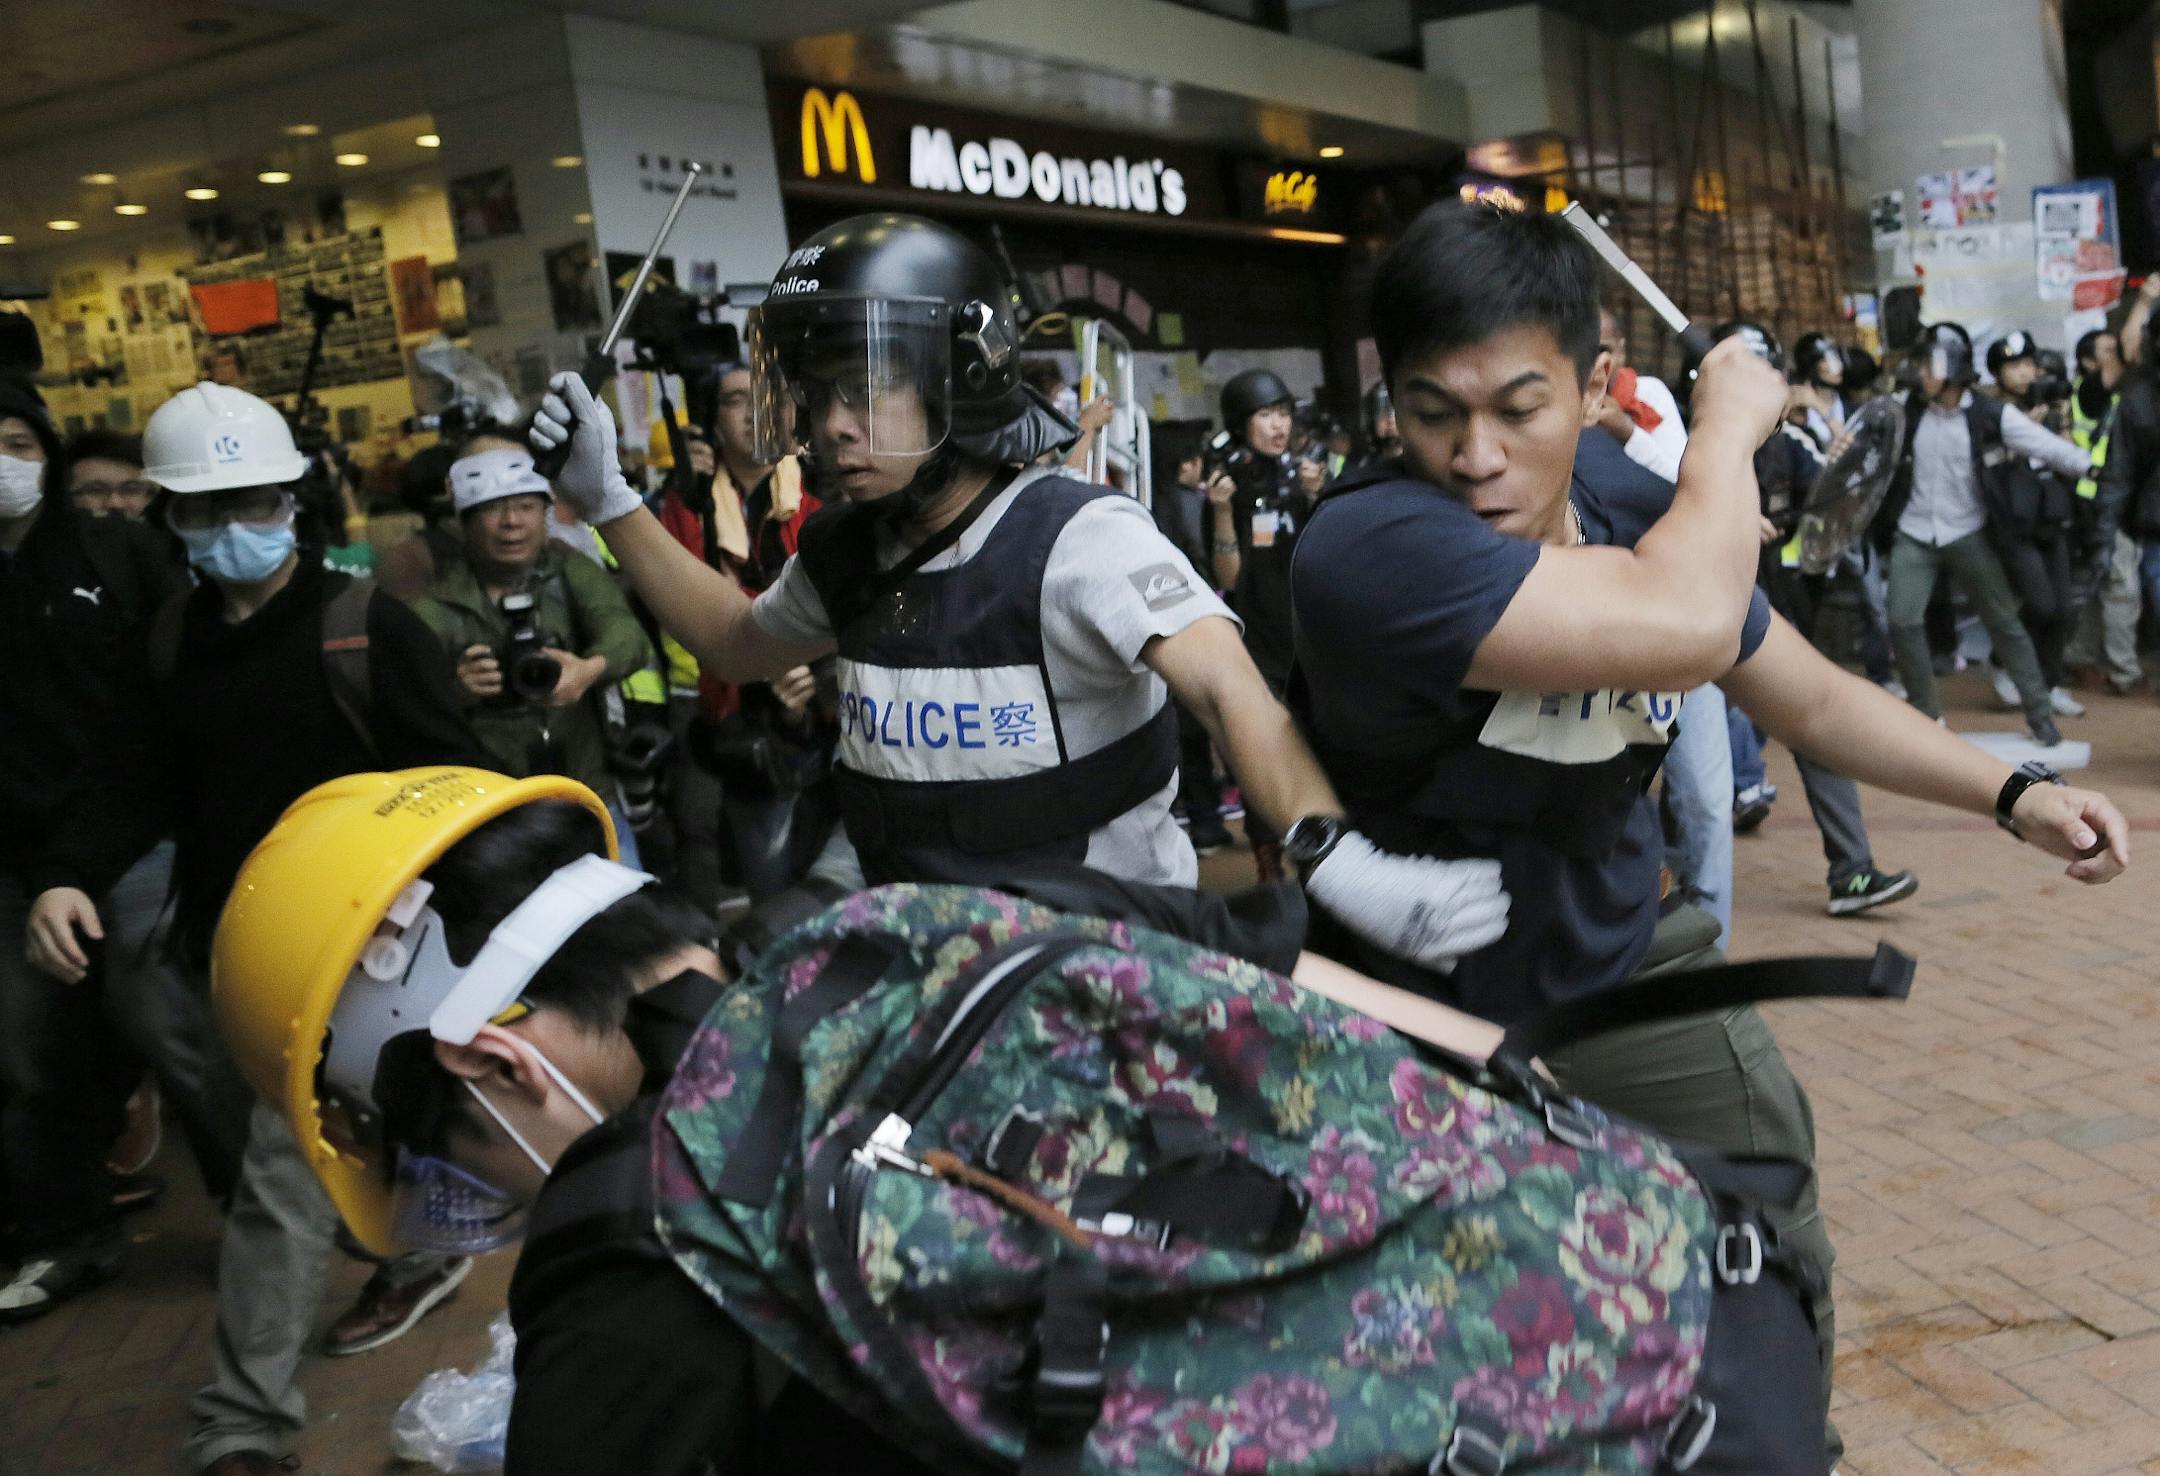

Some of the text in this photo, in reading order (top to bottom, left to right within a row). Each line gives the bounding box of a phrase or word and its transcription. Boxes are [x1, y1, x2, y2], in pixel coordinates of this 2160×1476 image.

[909, 124, 1187, 216] McDonald's
[770, 276, 820, 296] Police
[845, 691, 986, 749] POLICE
